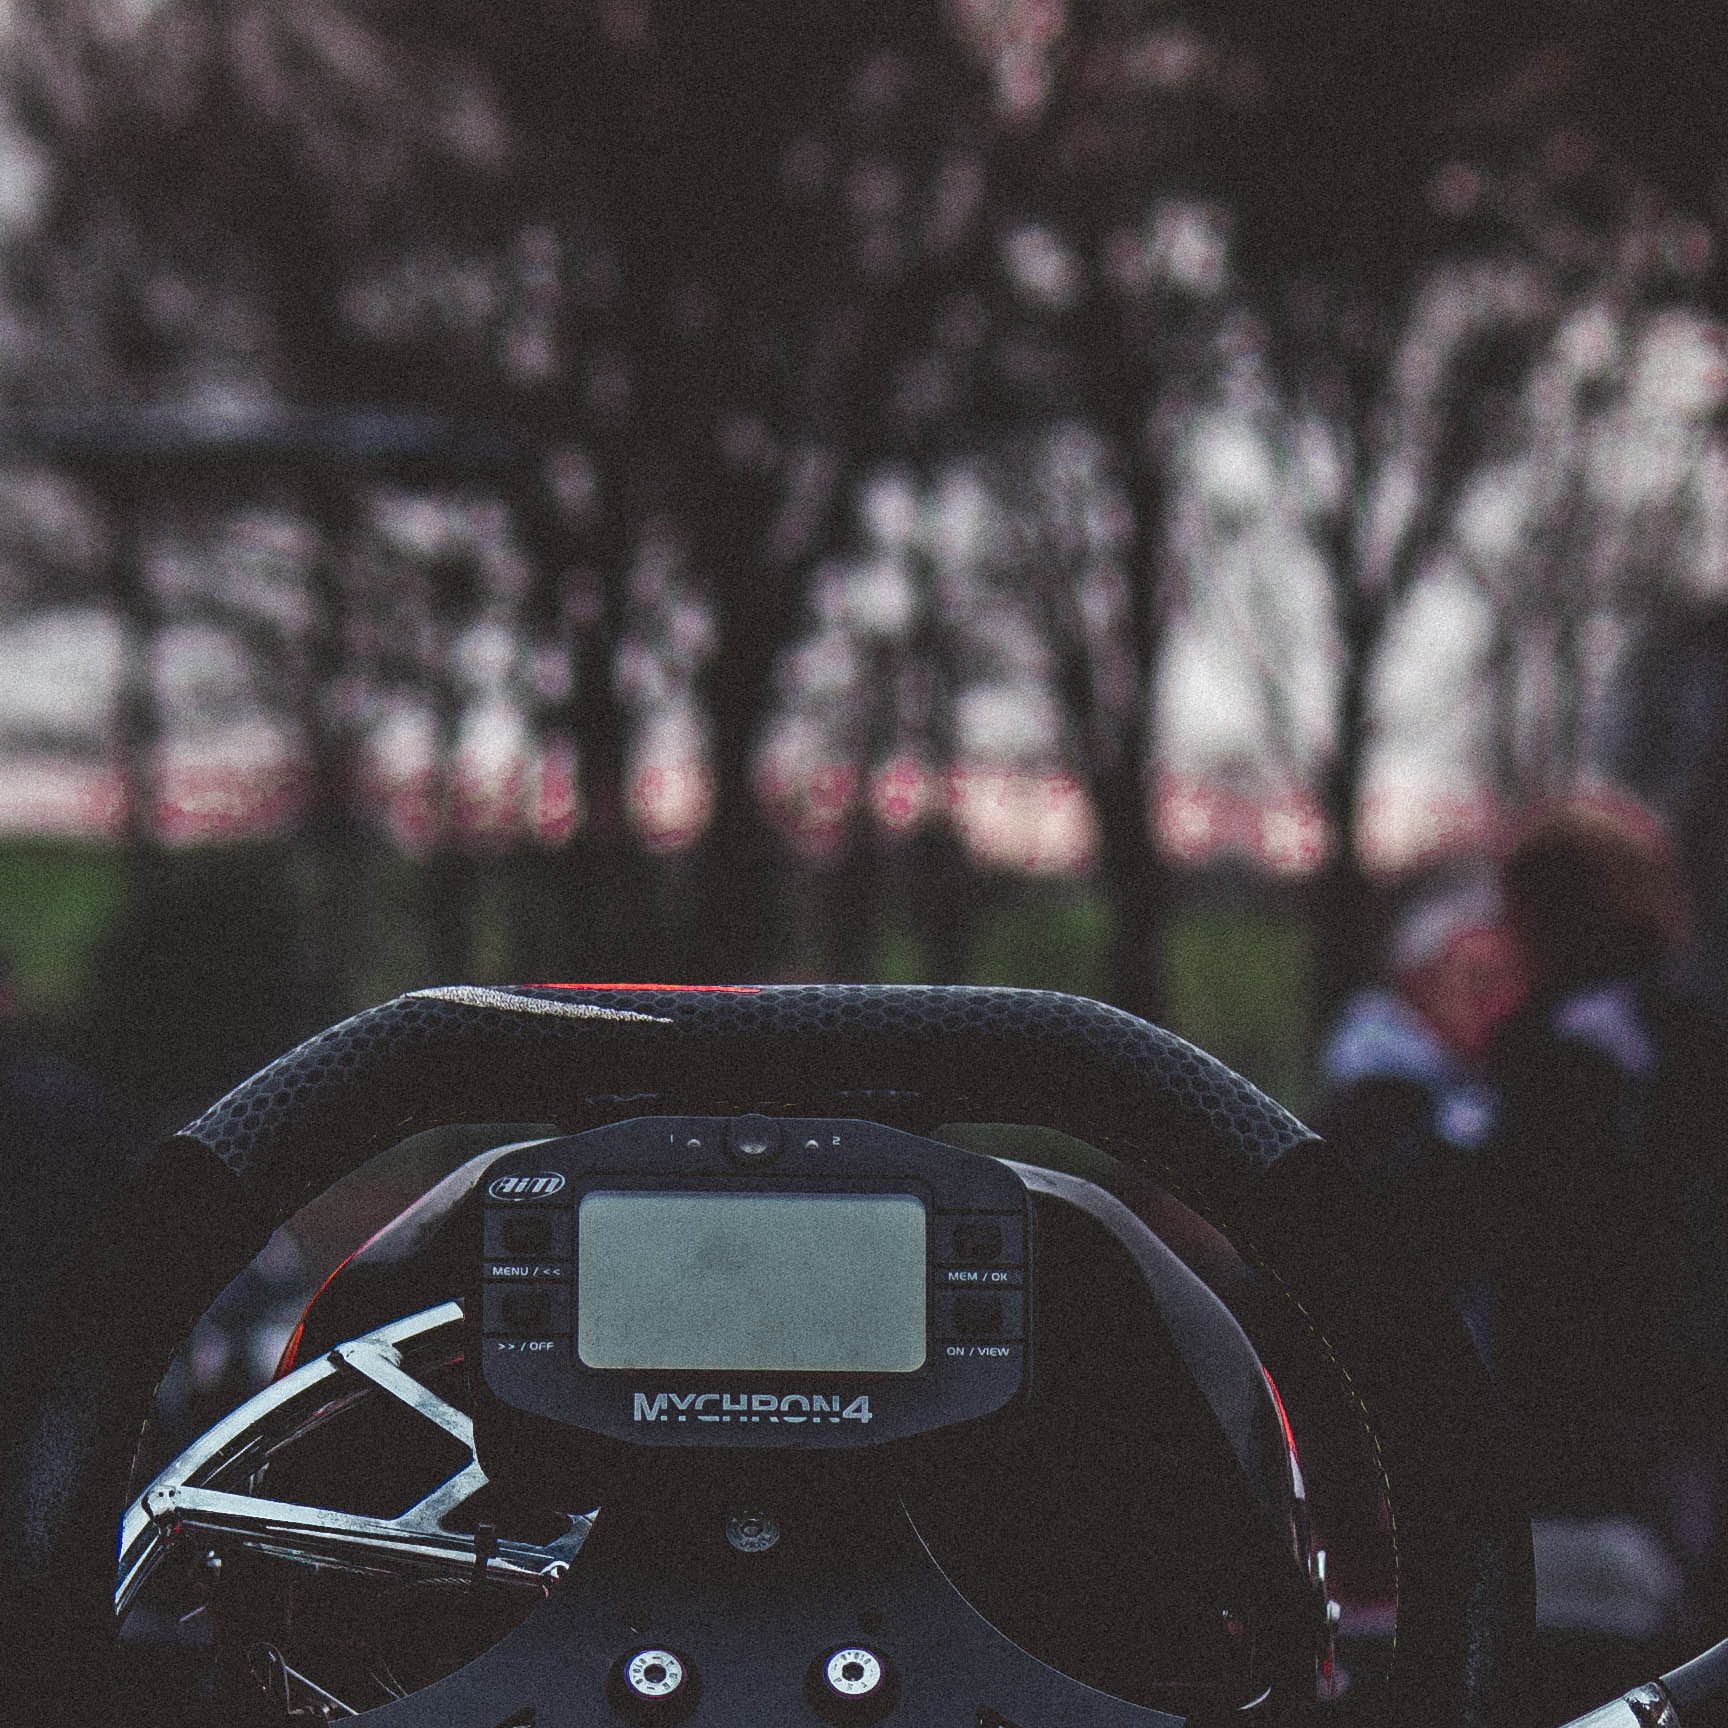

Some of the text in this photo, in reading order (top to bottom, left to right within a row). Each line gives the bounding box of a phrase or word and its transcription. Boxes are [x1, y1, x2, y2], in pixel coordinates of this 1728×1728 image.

[831, 1135, 841, 1146] 2
[492, 1266, 529, 1276] MENU
[948, 1271, 978, 1281] MEM
[991, 1272, 1008, 1282] OK
[529, 1341, 555, 1352] OFF
[946, 1346, 965, 1356] ON
[977, 1346, 1010, 1357] VIEW
[633, 1392, 873, 1424] MYCHRON4
